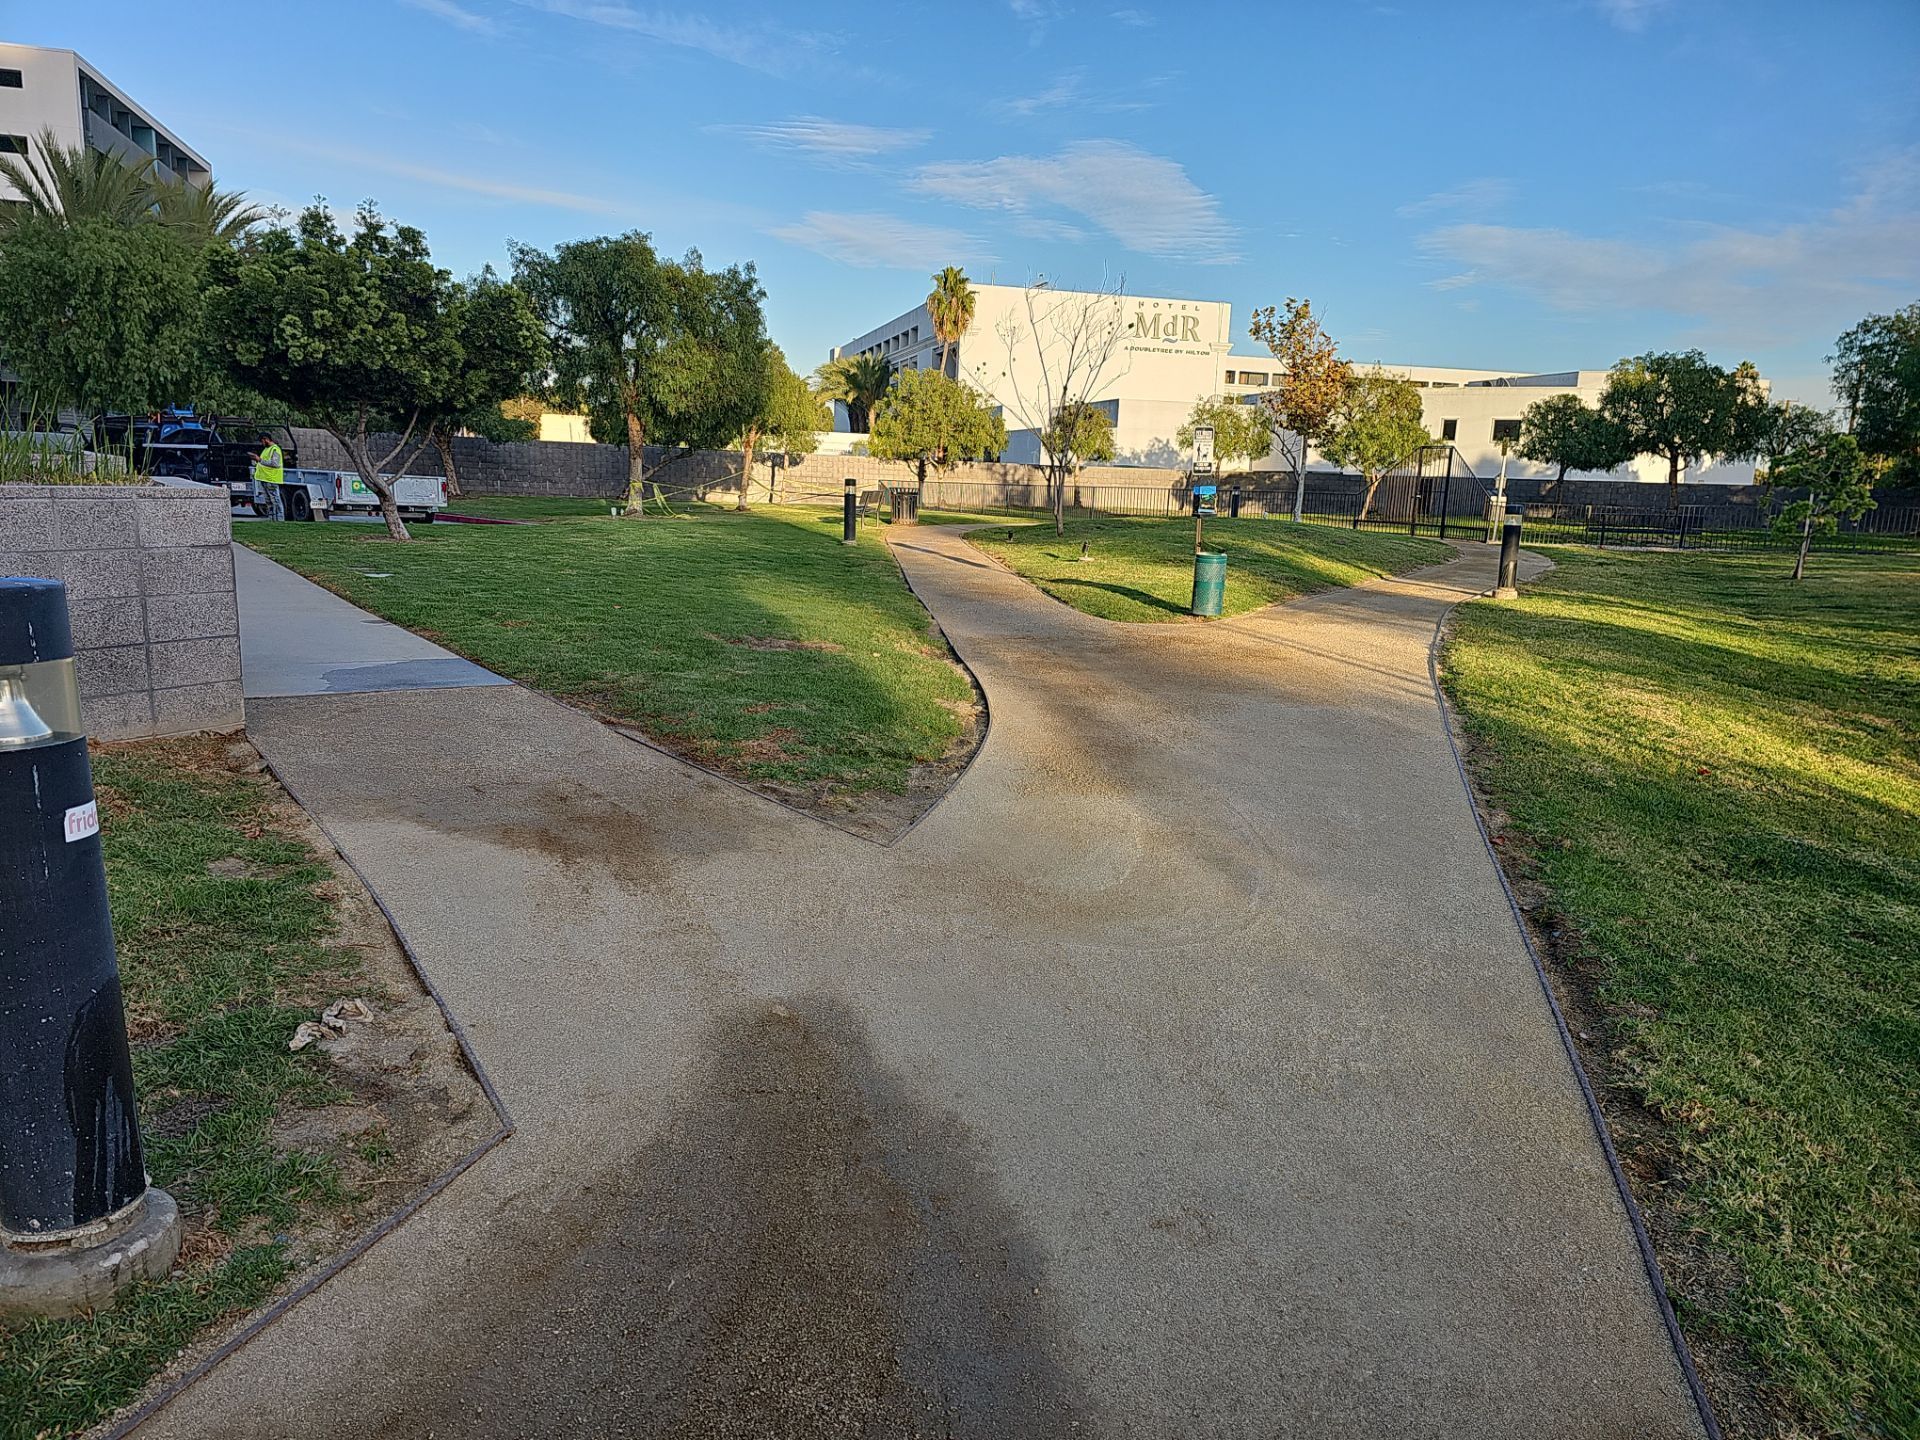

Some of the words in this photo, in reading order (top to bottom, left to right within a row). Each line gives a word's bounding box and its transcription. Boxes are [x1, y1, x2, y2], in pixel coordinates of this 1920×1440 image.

[1138, 301, 1200, 311] HOTEL
[1133, 312, 1201, 342] MdR
[1129, 345, 1173, 354] DOUBLETREE
